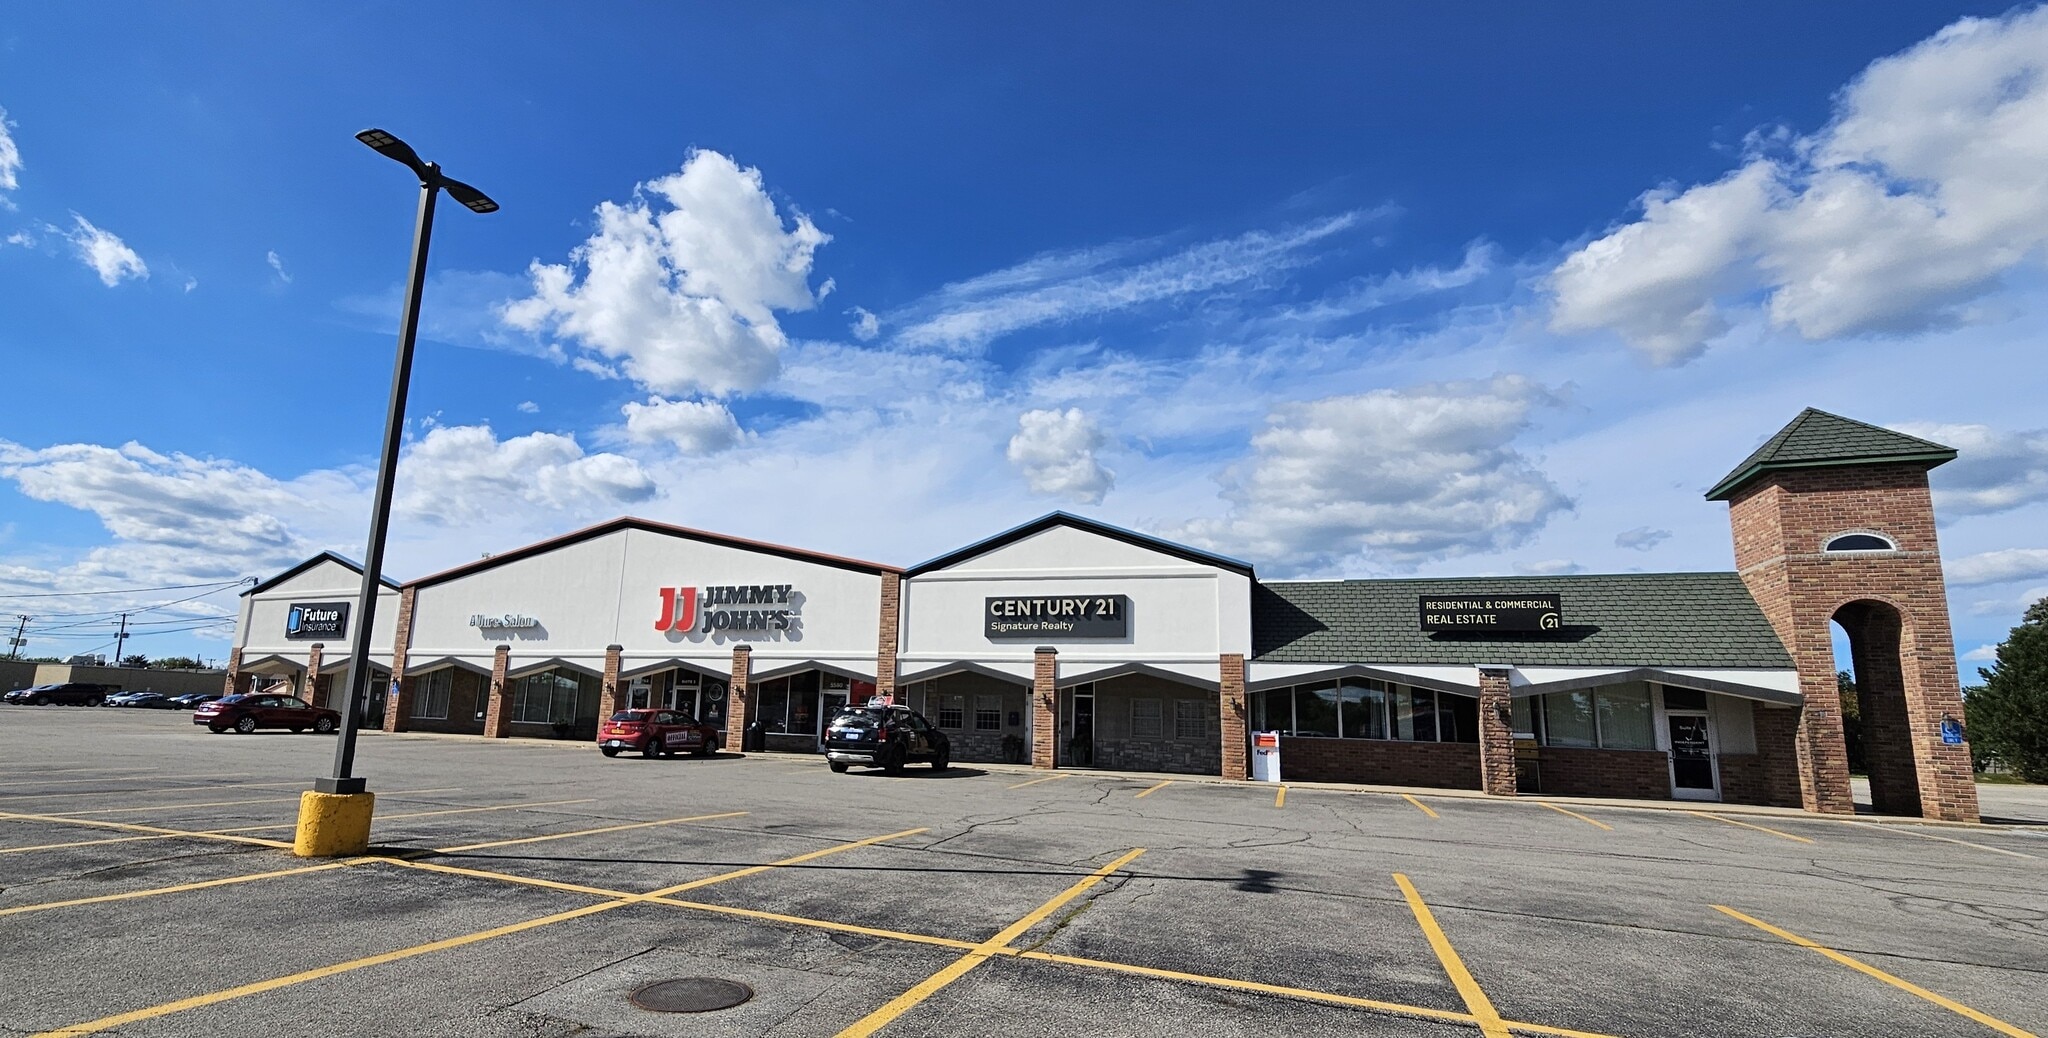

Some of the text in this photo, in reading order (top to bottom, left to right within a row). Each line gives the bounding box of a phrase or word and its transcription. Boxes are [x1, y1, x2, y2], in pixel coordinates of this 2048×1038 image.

[703, 585, 792, 608] JIMMY
[655, 587, 698, 631] JJ
[990, 598, 1115, 616] CENTURY 21
[1426, 600, 1555, 610] RESIDENTIAL & COMMERCIAL
[303, 609, 338, 621] Future
[503, 614, 536, 628] Salon
[1427, 614, 1497, 625] REAL ESTATE
[302, 622, 337, 631] Insurance
[702, 610, 789, 633] JOHN'S
[991, 621, 1074, 633] Signature Realty
[1546, 618, 1559, 629] 21
